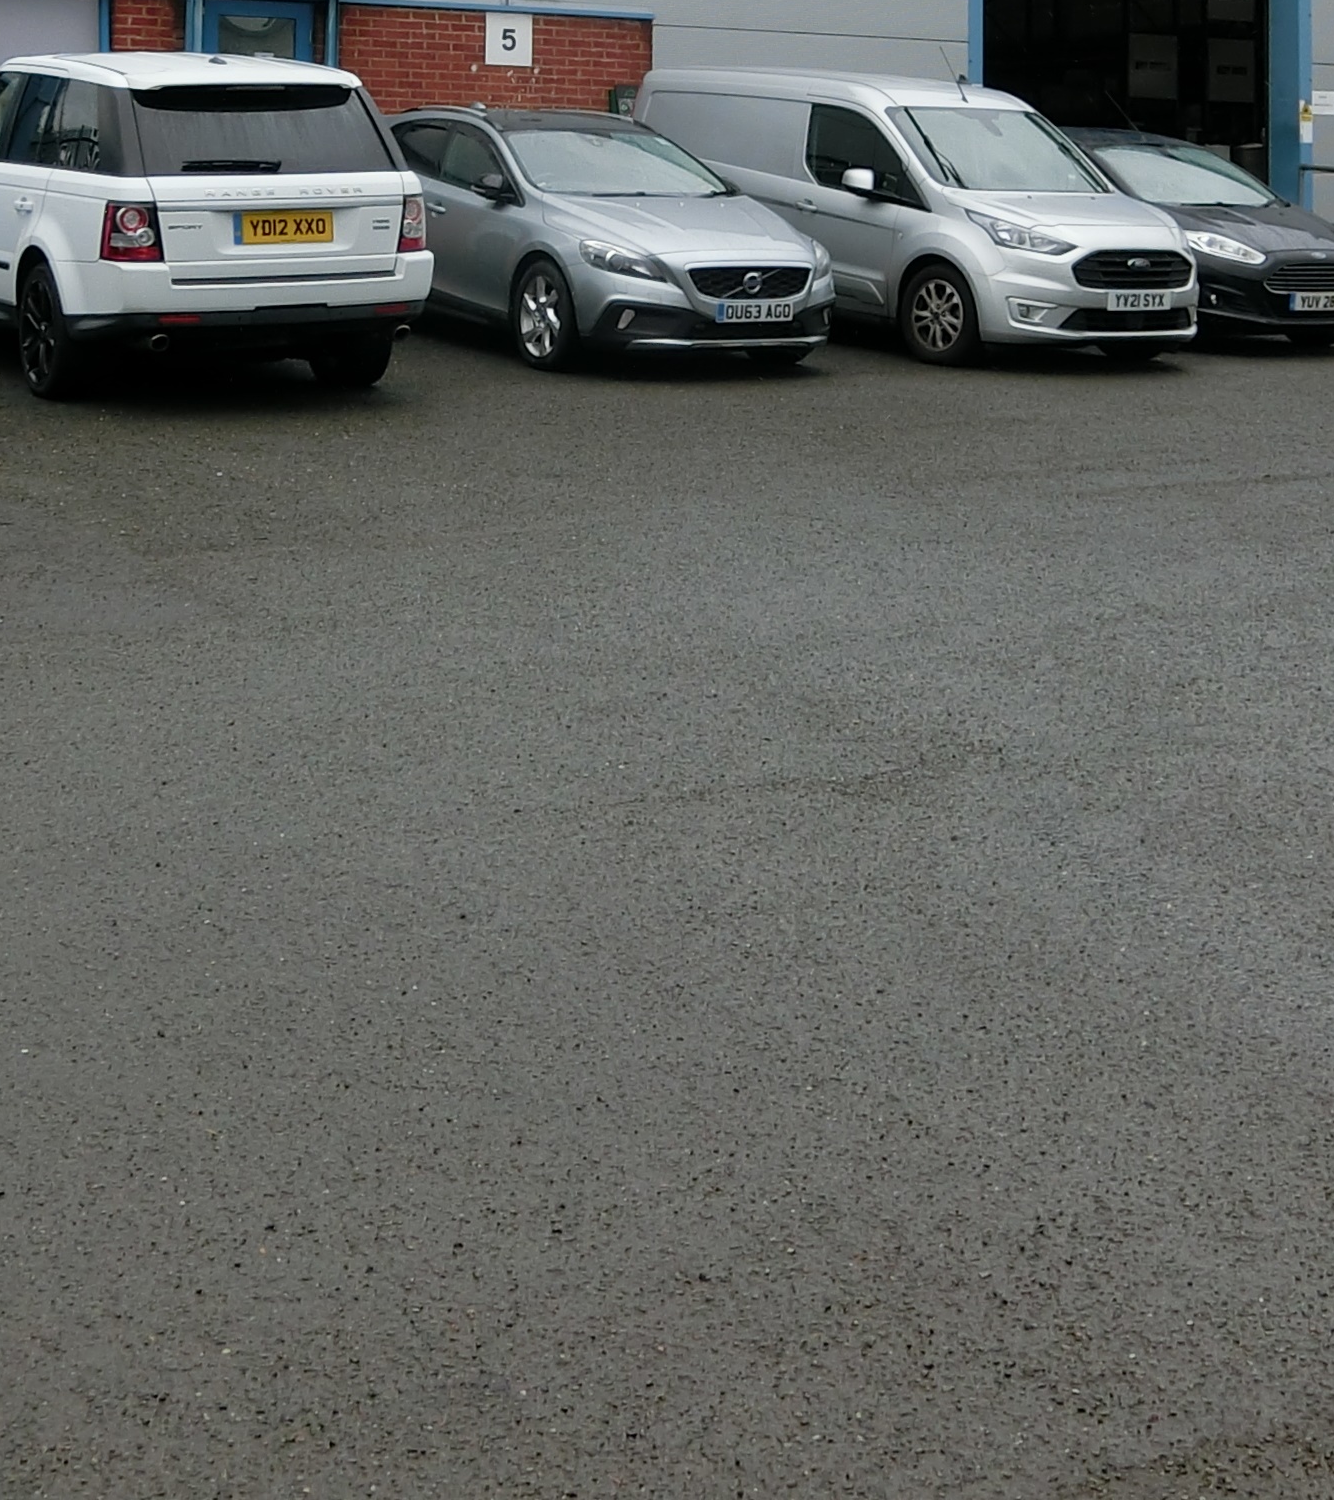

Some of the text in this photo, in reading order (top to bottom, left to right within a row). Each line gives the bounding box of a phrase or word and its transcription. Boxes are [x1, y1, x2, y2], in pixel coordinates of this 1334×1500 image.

[501, 28, 517, 51] 5
[204, 186, 363, 198] RANGE ROVER
[250, 218, 326, 236] YD12 XXO
[1143, 293, 1165, 308] SYX
[726, 303, 791, 320] OU63 AGO
